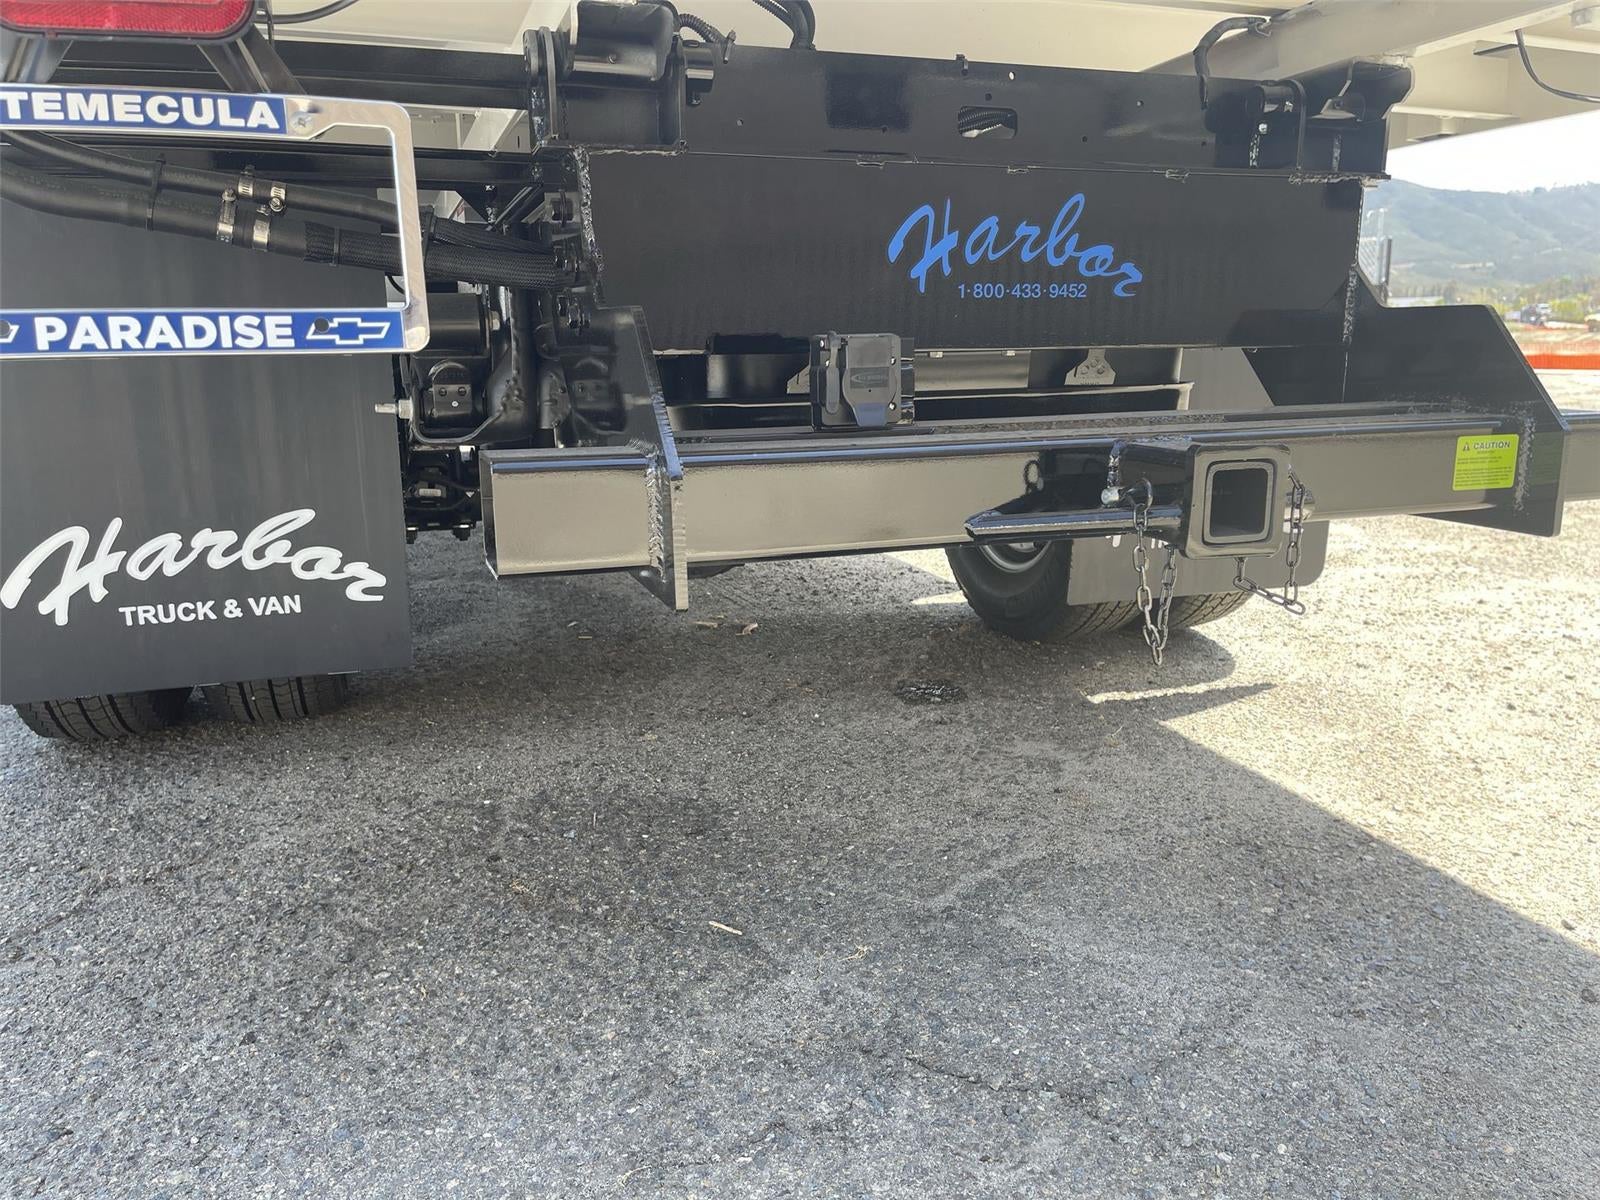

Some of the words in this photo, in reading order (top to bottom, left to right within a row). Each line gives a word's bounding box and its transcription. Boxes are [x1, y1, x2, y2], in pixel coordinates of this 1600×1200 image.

[0, 91, 280, 129] TEMECULA
[887, 193, 1144, 298] Harbor
[34, 315, 296, 350] PARADISE
[1473, 441, 1511, 450] CAUTION
[0, 508, 387, 627] Harbor
[119, 599, 218, 627] TRUCK
[223, 598, 244, 619] &
[248, 595, 302, 617] VAN
